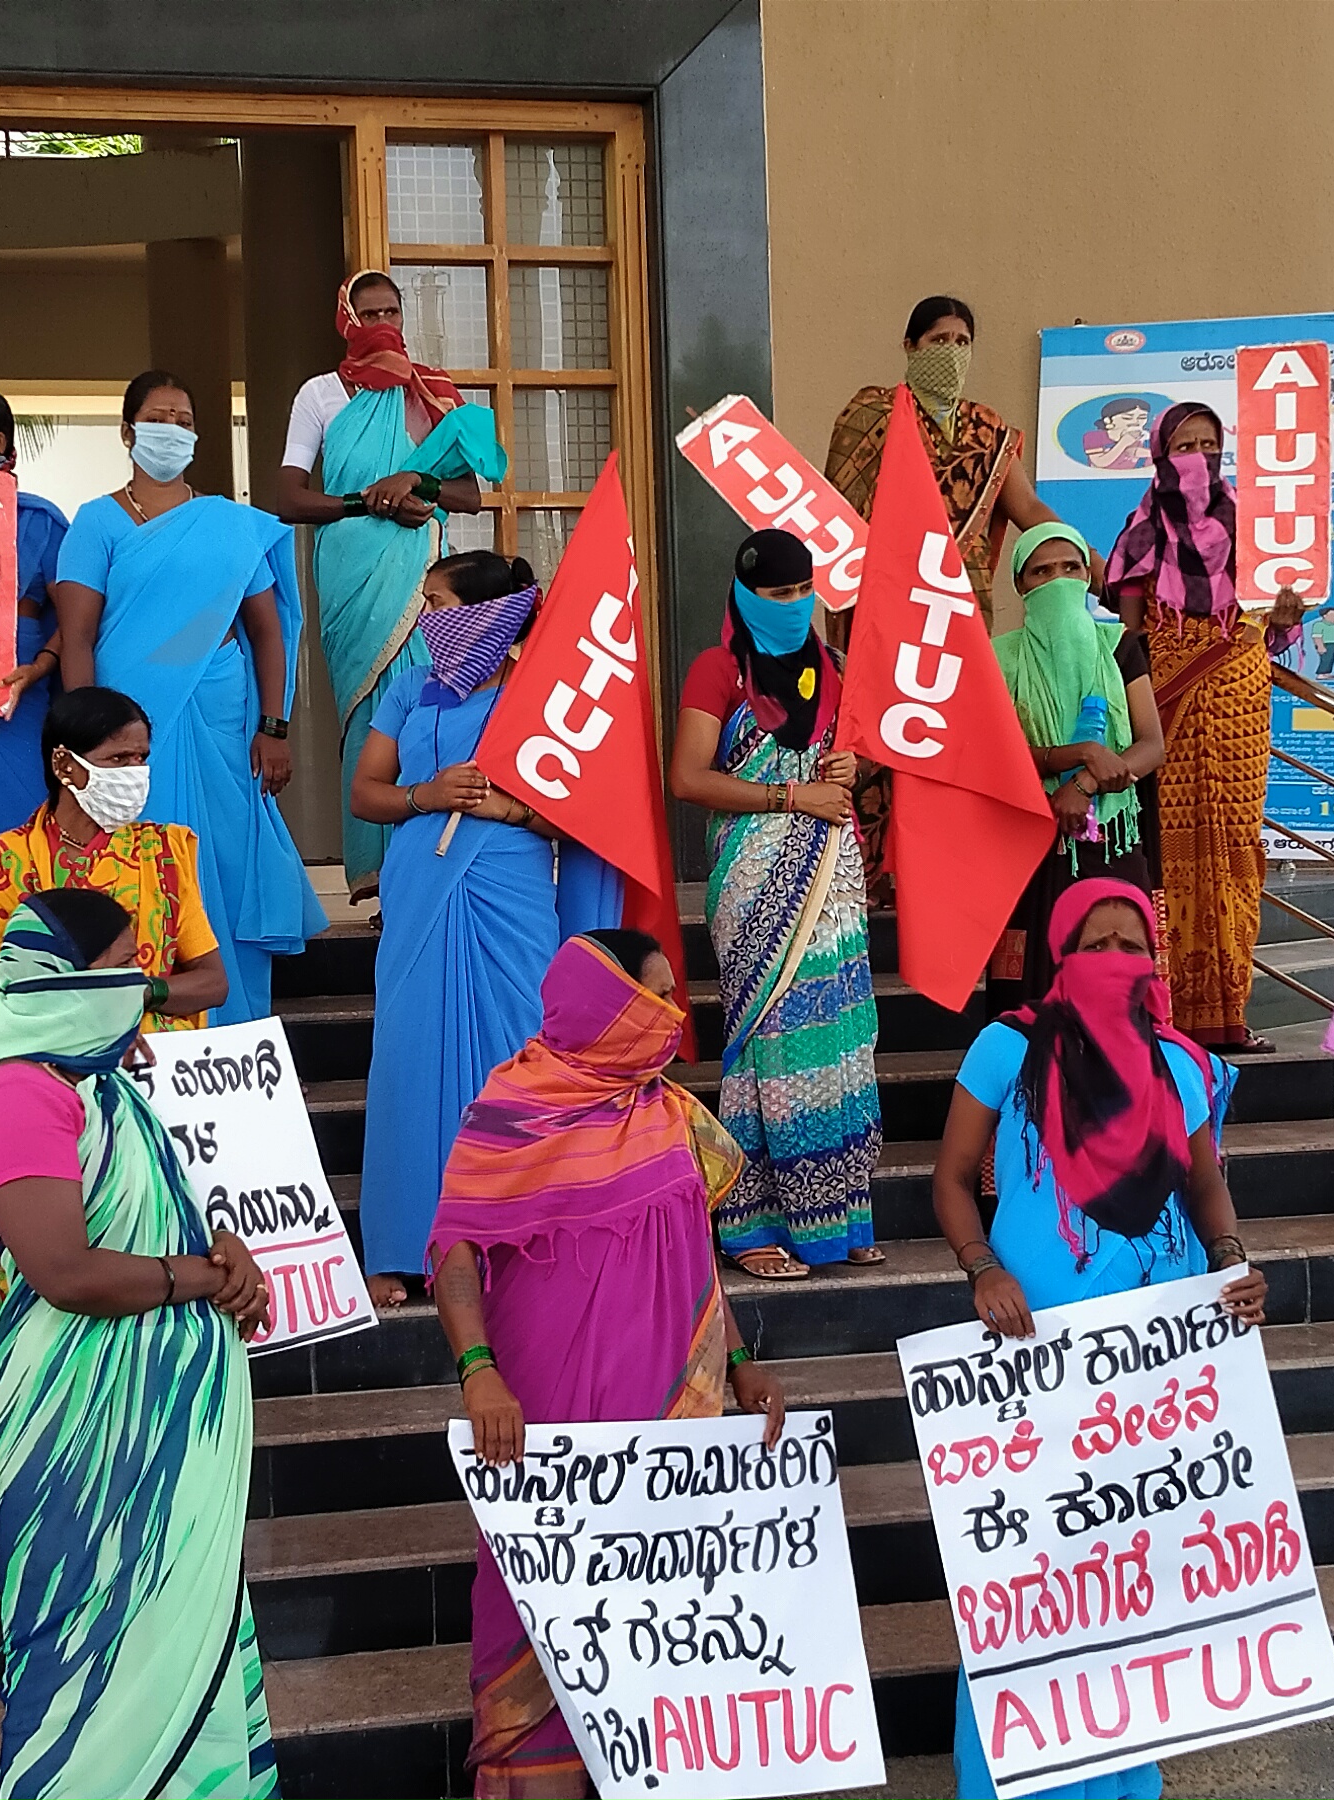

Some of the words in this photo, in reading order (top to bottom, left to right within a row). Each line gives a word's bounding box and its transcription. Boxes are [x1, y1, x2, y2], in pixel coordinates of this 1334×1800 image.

[1253, 349, 1320, 595] AIUTUC
[880, 530, 975, 759] UTUC
[927, 1419, 1044, 1486] ಬಾಕಿ
[1071, 1364, 1220, 1461] ವೇತನ
[961, 1488, 1030, 1553] ಈ
[1044, 1428, 1254, 1539] ಕೂಡಲೇ
[957, 1528, 1155, 1656] ಬಿಡುಗಡೆ
[1181, 1499, 1303, 1601] ಮಾಡಿ
[653, 1684, 857, 1774] AIUTUC
[991, 1622, 1313, 1759] AIUTUC
